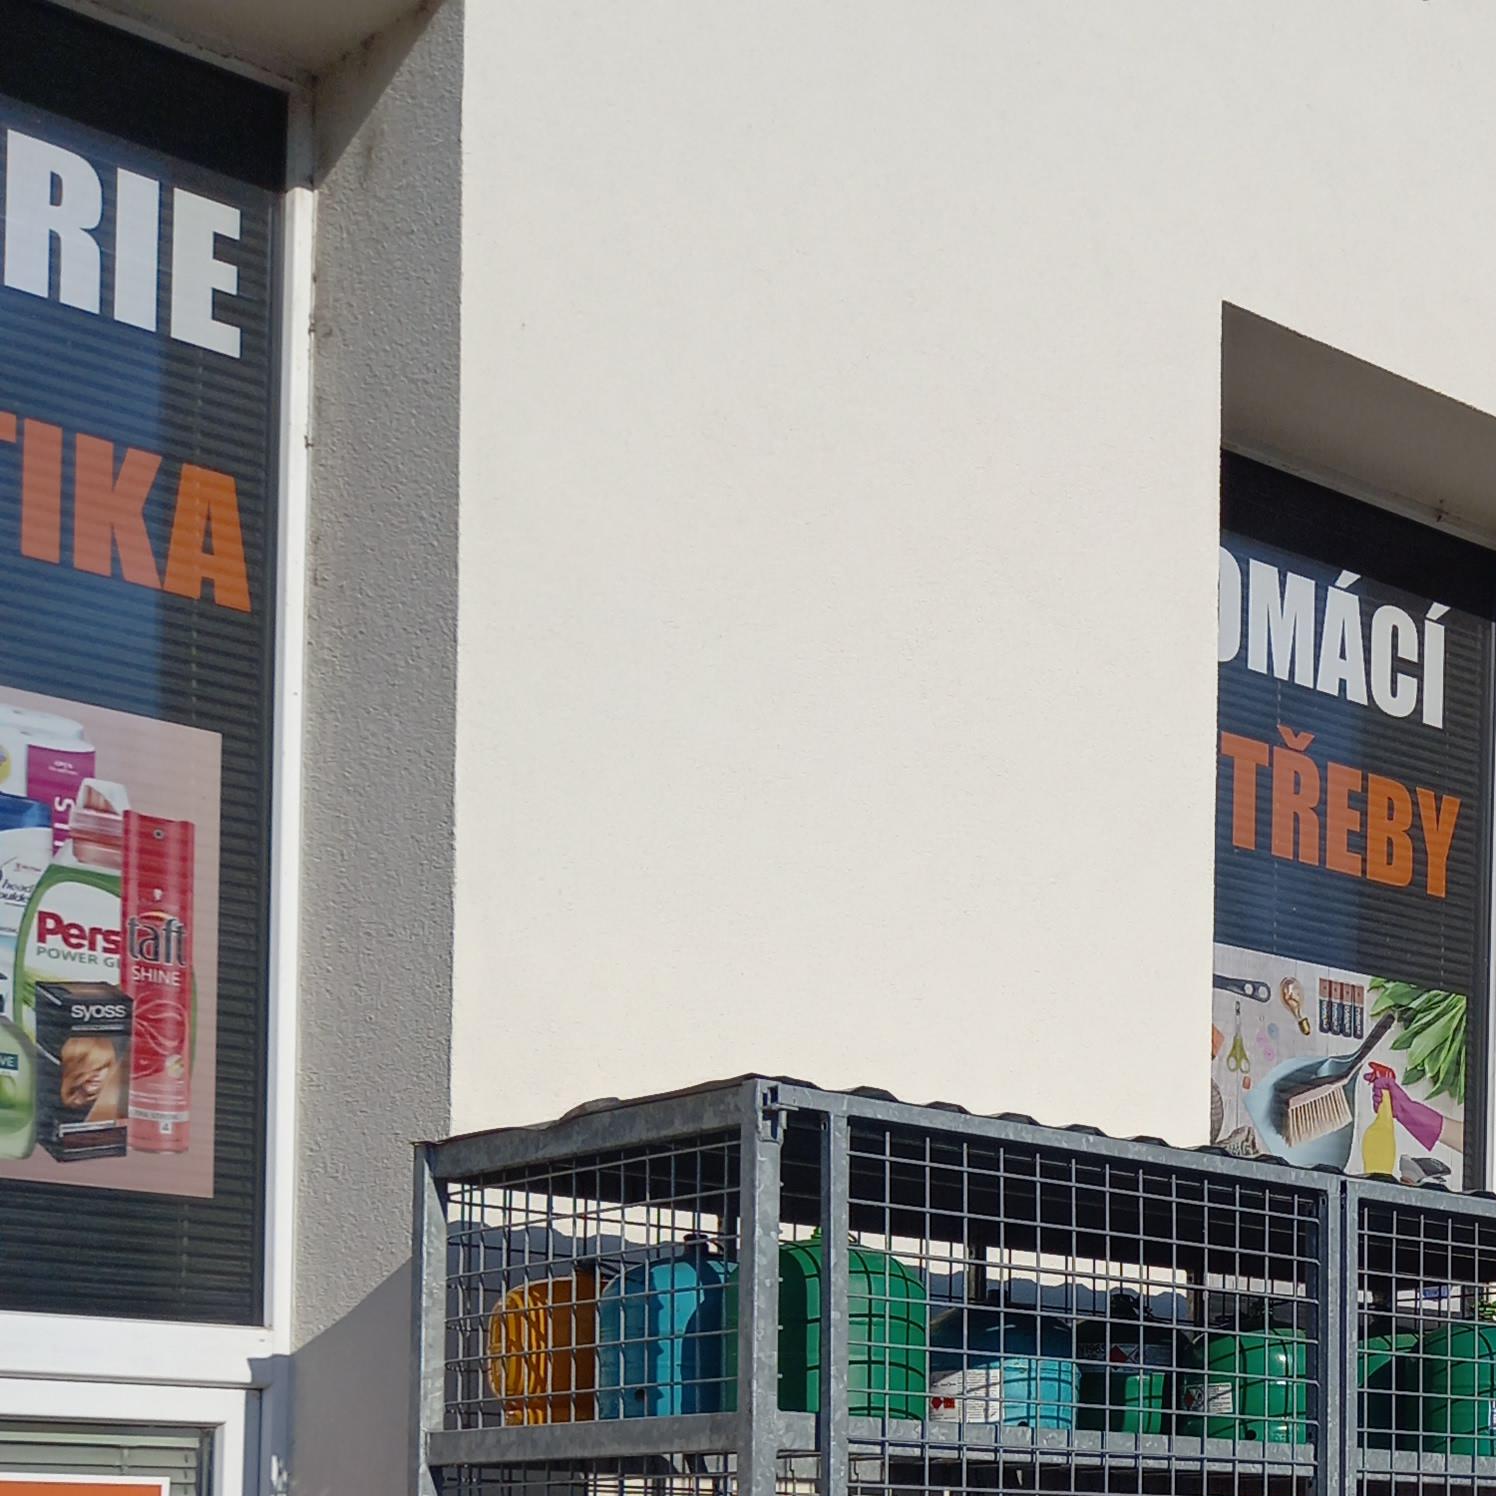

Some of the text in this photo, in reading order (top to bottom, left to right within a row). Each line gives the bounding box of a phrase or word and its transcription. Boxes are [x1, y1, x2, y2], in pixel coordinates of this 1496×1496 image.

[4, 128, 241, 359] RIE
[1221, 725, 1461, 898] TŘEBY
[36, 910, 121, 955] Pers
[128, 916, 186, 967] taft
[36, 946, 98, 965] POWER
[131, 965, 181, 986] SHINE
[71, 1004, 126, 1022] syoss
